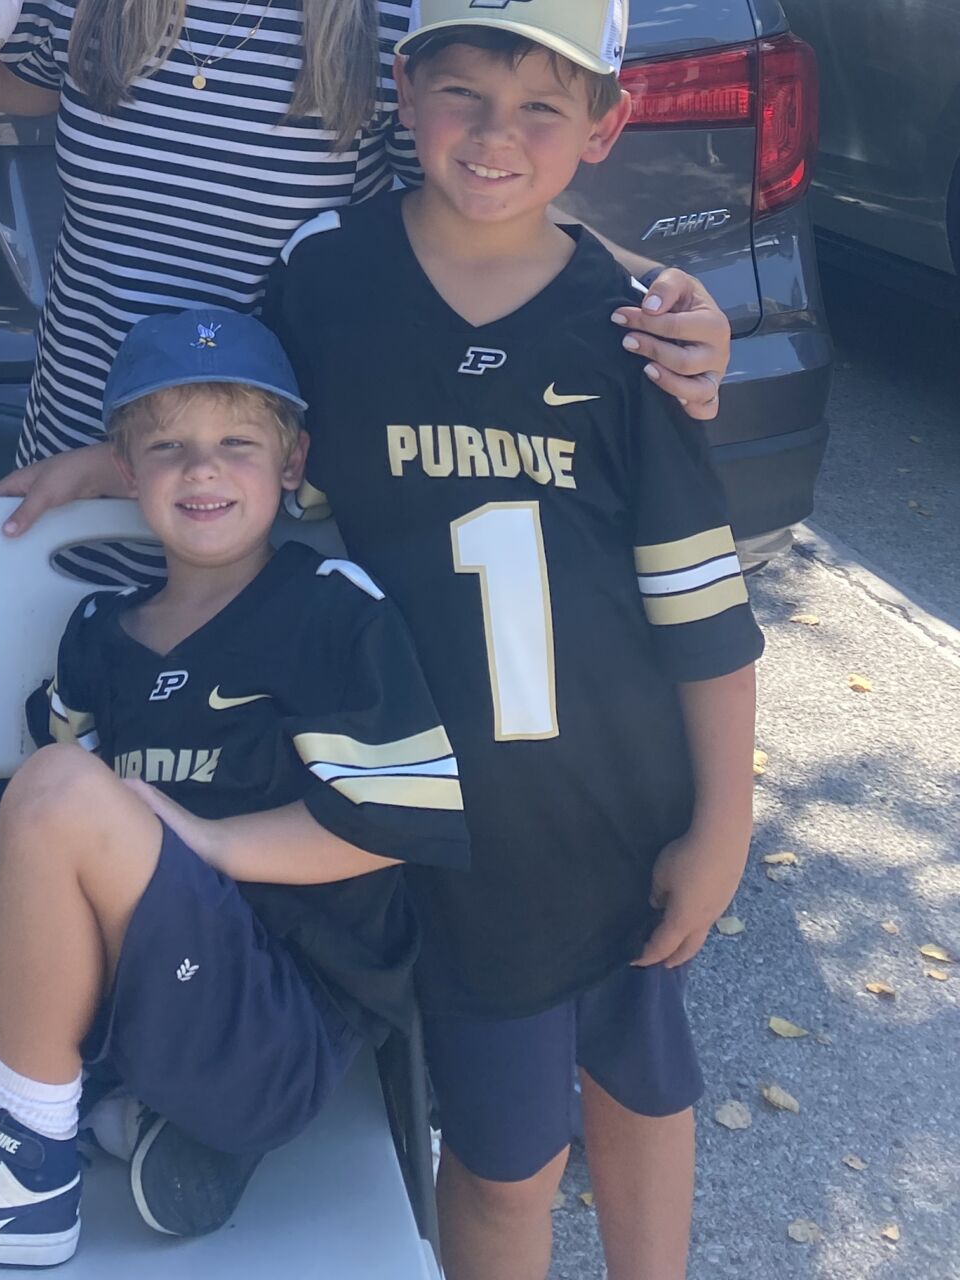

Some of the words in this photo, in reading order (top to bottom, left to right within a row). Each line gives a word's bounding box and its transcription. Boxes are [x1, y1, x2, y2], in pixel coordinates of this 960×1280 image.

[457, 346, 508, 375] P
[386, 424, 577, 489] PURDUE
[450, 500, 560, 742] 1
[149, 670, 189, 701] P
